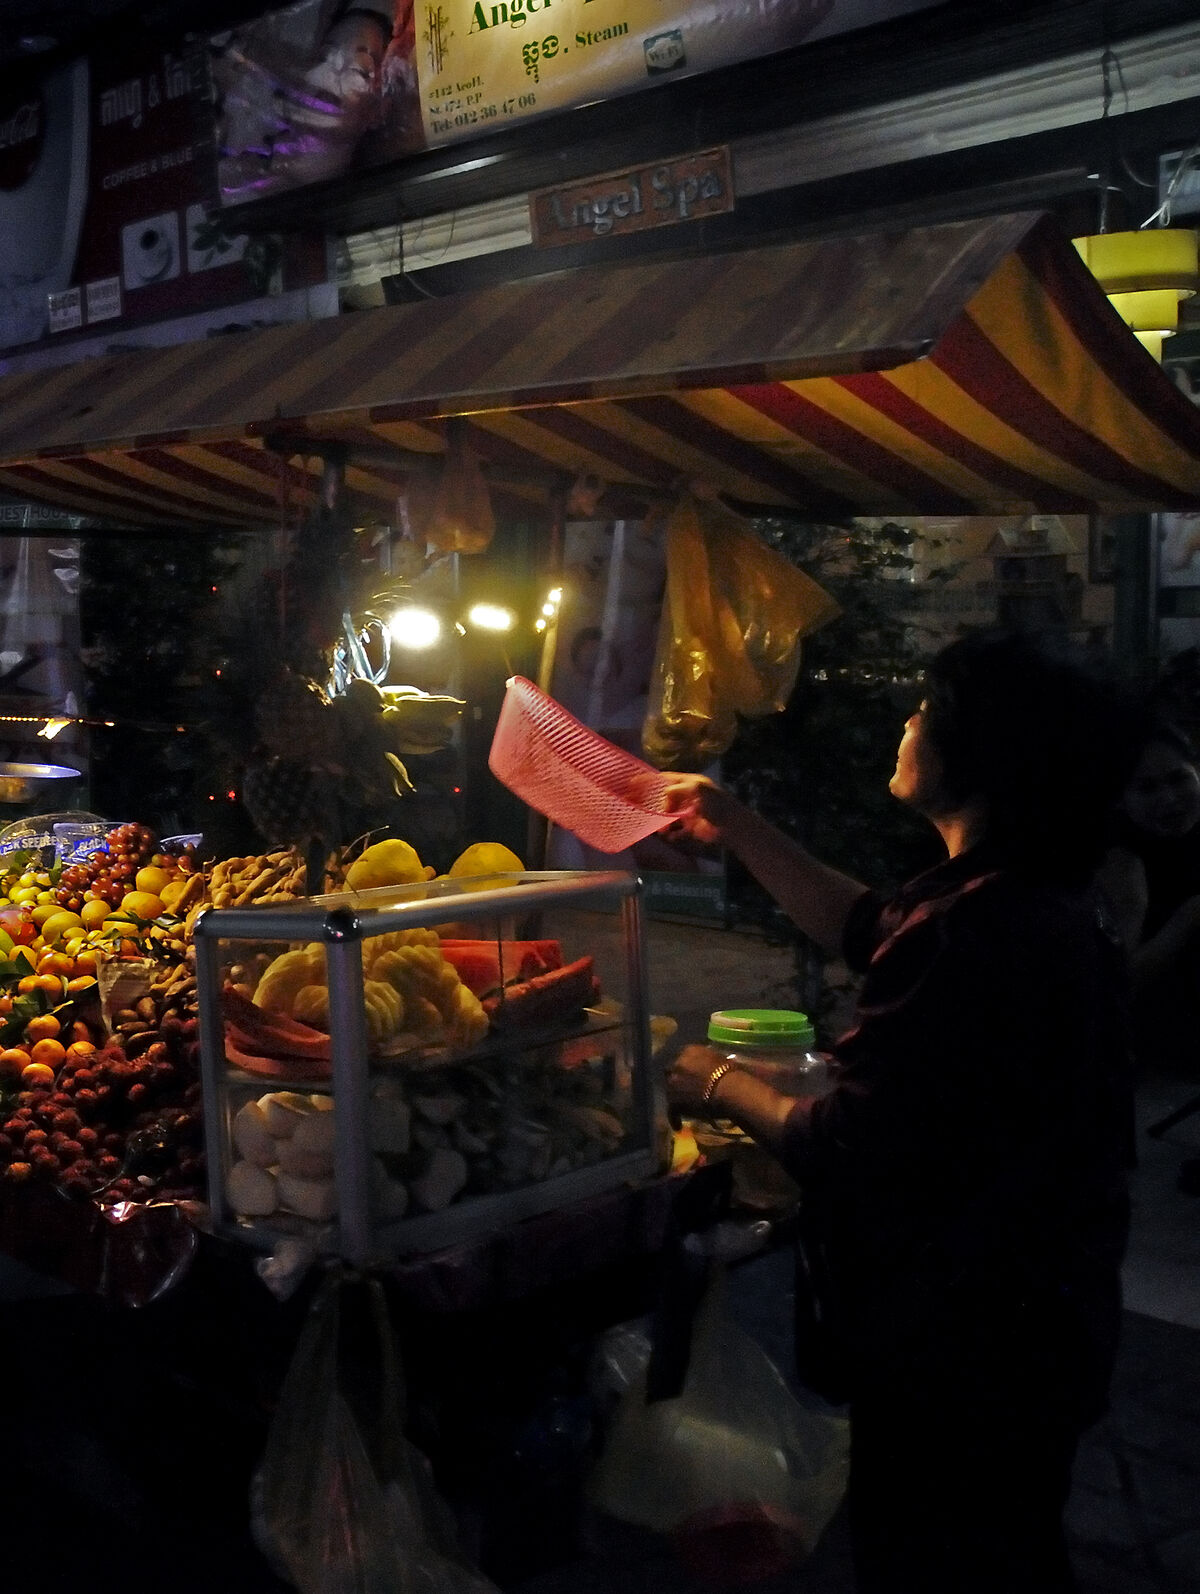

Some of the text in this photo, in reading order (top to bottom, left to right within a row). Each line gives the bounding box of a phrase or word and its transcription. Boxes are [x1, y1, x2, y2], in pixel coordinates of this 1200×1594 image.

[467, 0, 551, 35] Ange
[576, 22, 629, 49] Steam
[549, 166, 722, 235] Angel Spa
